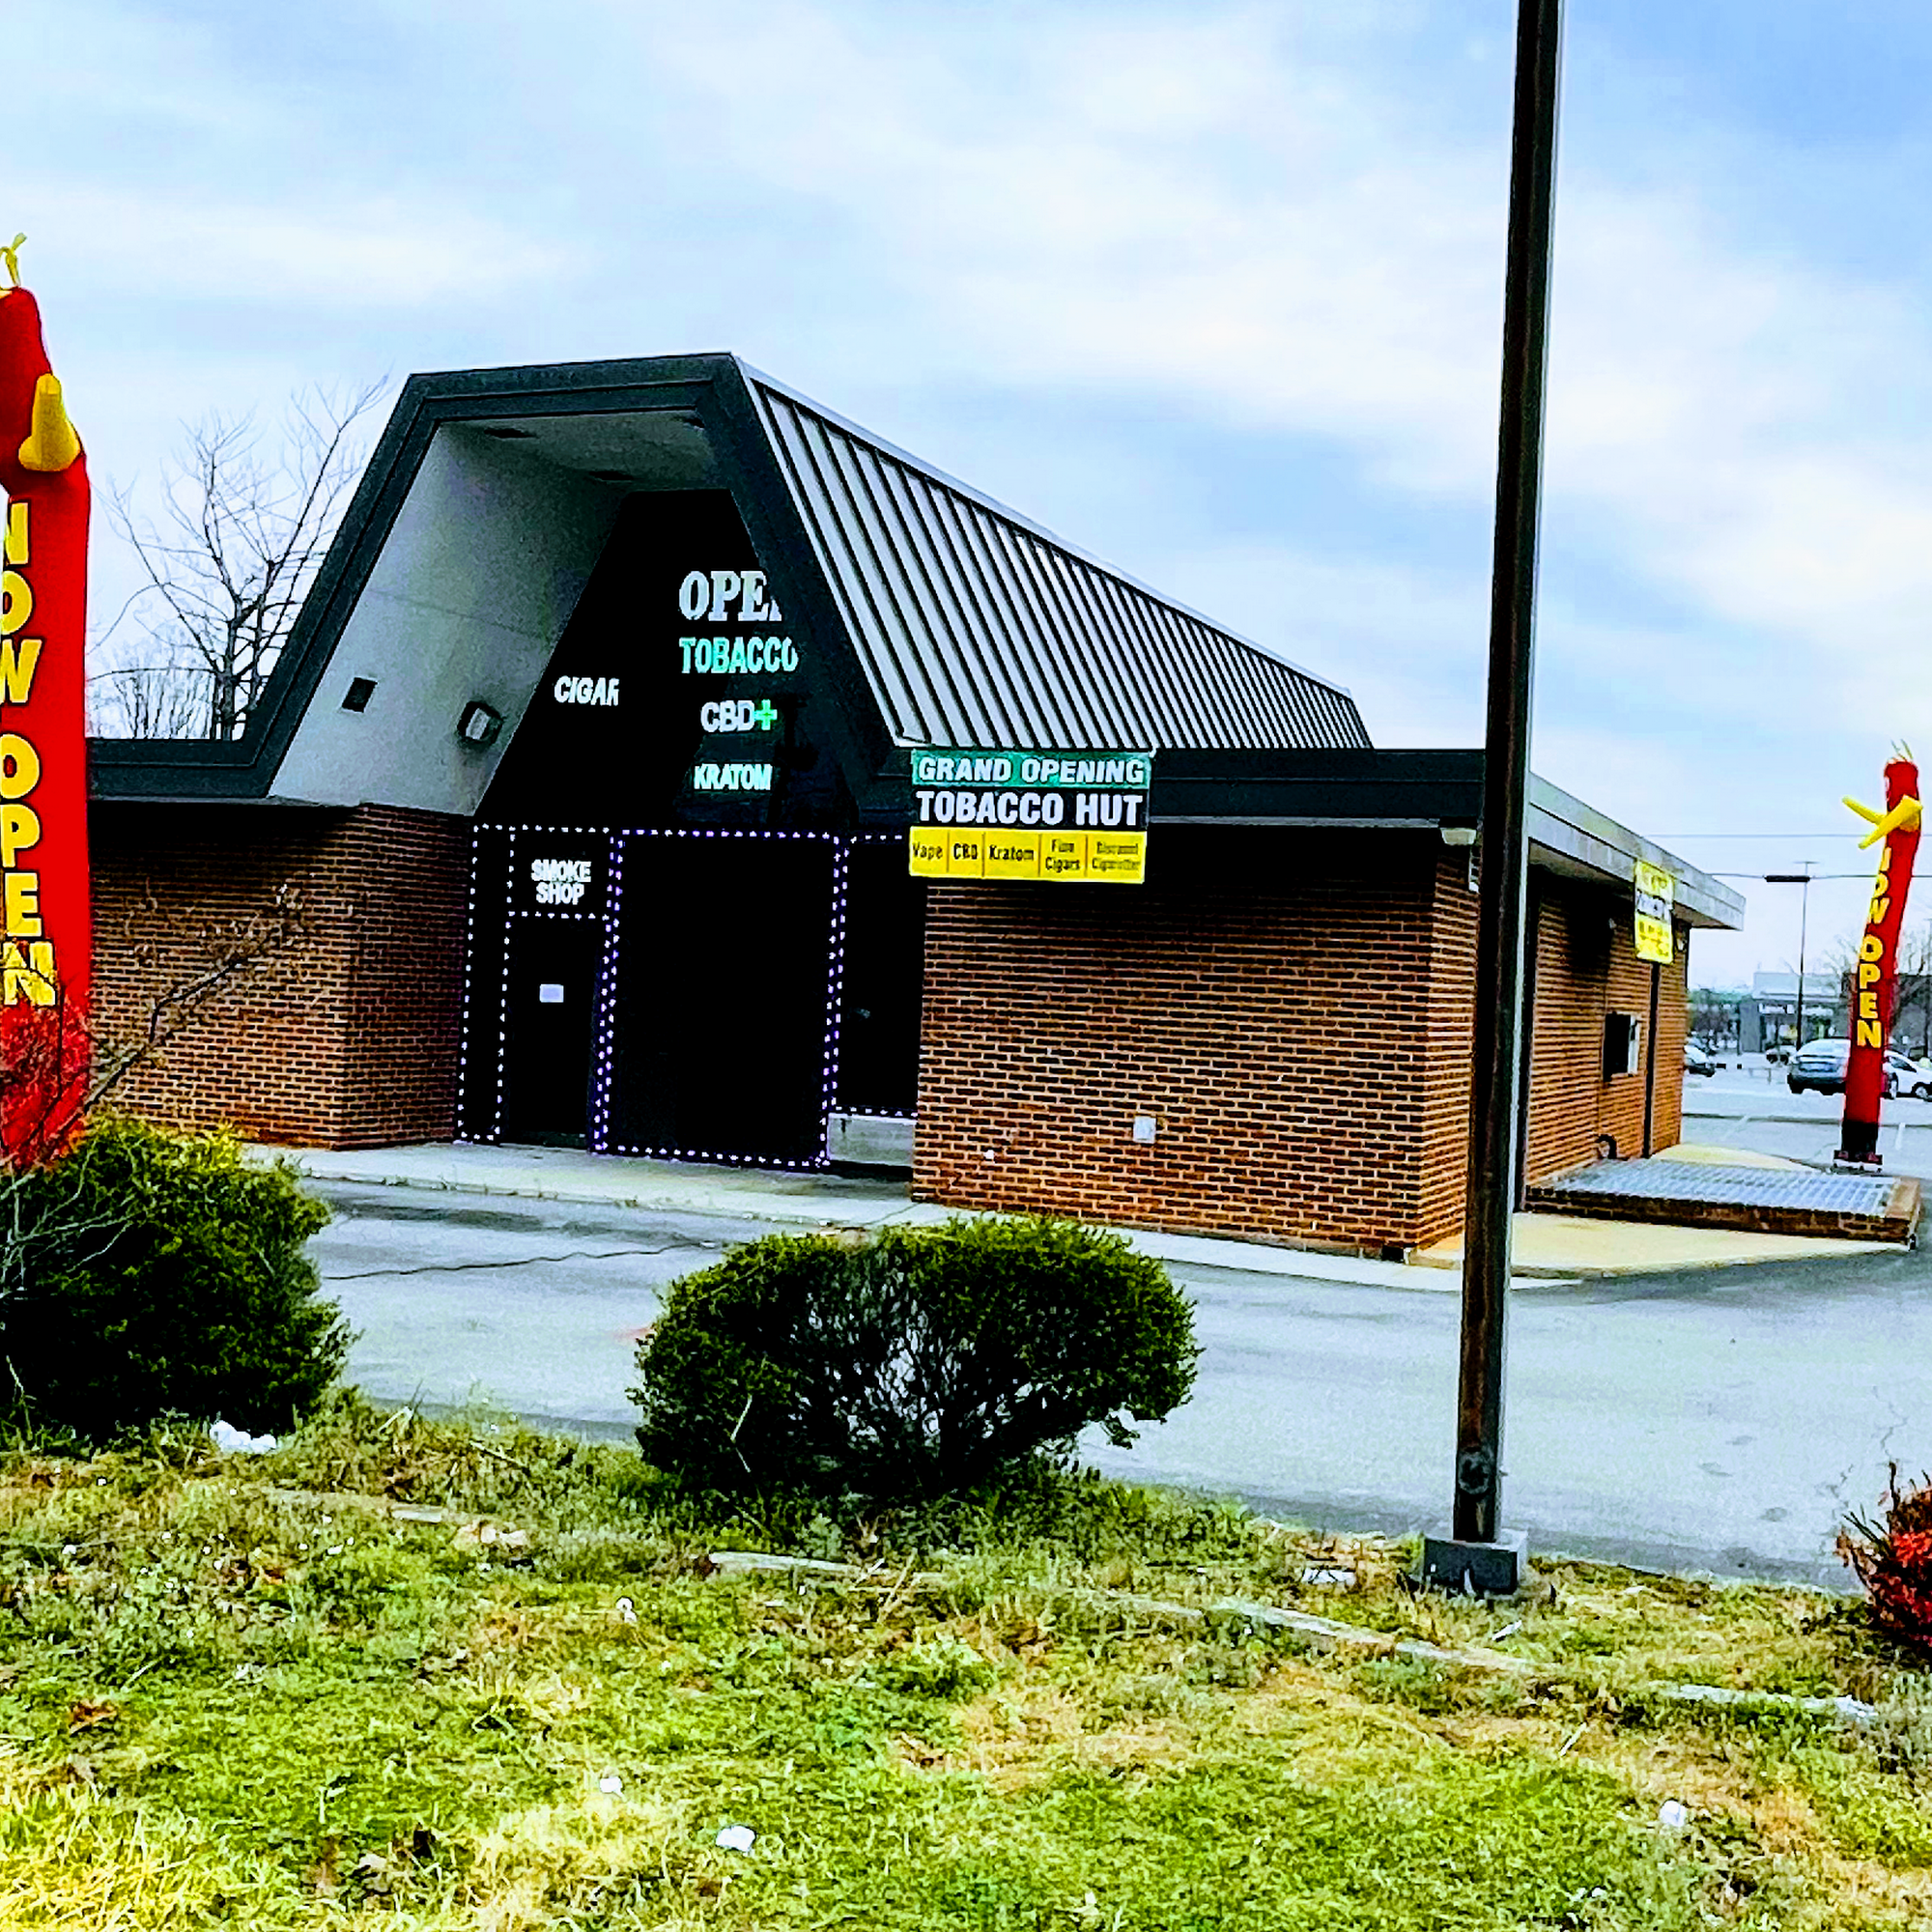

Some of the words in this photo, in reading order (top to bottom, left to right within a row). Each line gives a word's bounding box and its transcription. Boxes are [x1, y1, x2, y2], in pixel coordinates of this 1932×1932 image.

[679, 636, 799, 673] TOBACCO
[694, 763, 773, 790] KRATOM
[919, 756, 1011, 781] GRAND
[1021, 758, 1145, 783] OPENING
[916, 790, 1064, 825] TOBACCO
[1075, 792, 1144, 826] HUT
[912, 841, 943, 860] Vape
[953, 843, 978, 860] CBD
[989, 844, 1035, 861] Kratom
[531, 859, 591, 883] SMOKE
[536, 881, 584, 905] SHOP
[1857, 934, 1884, 1049] OPEN
